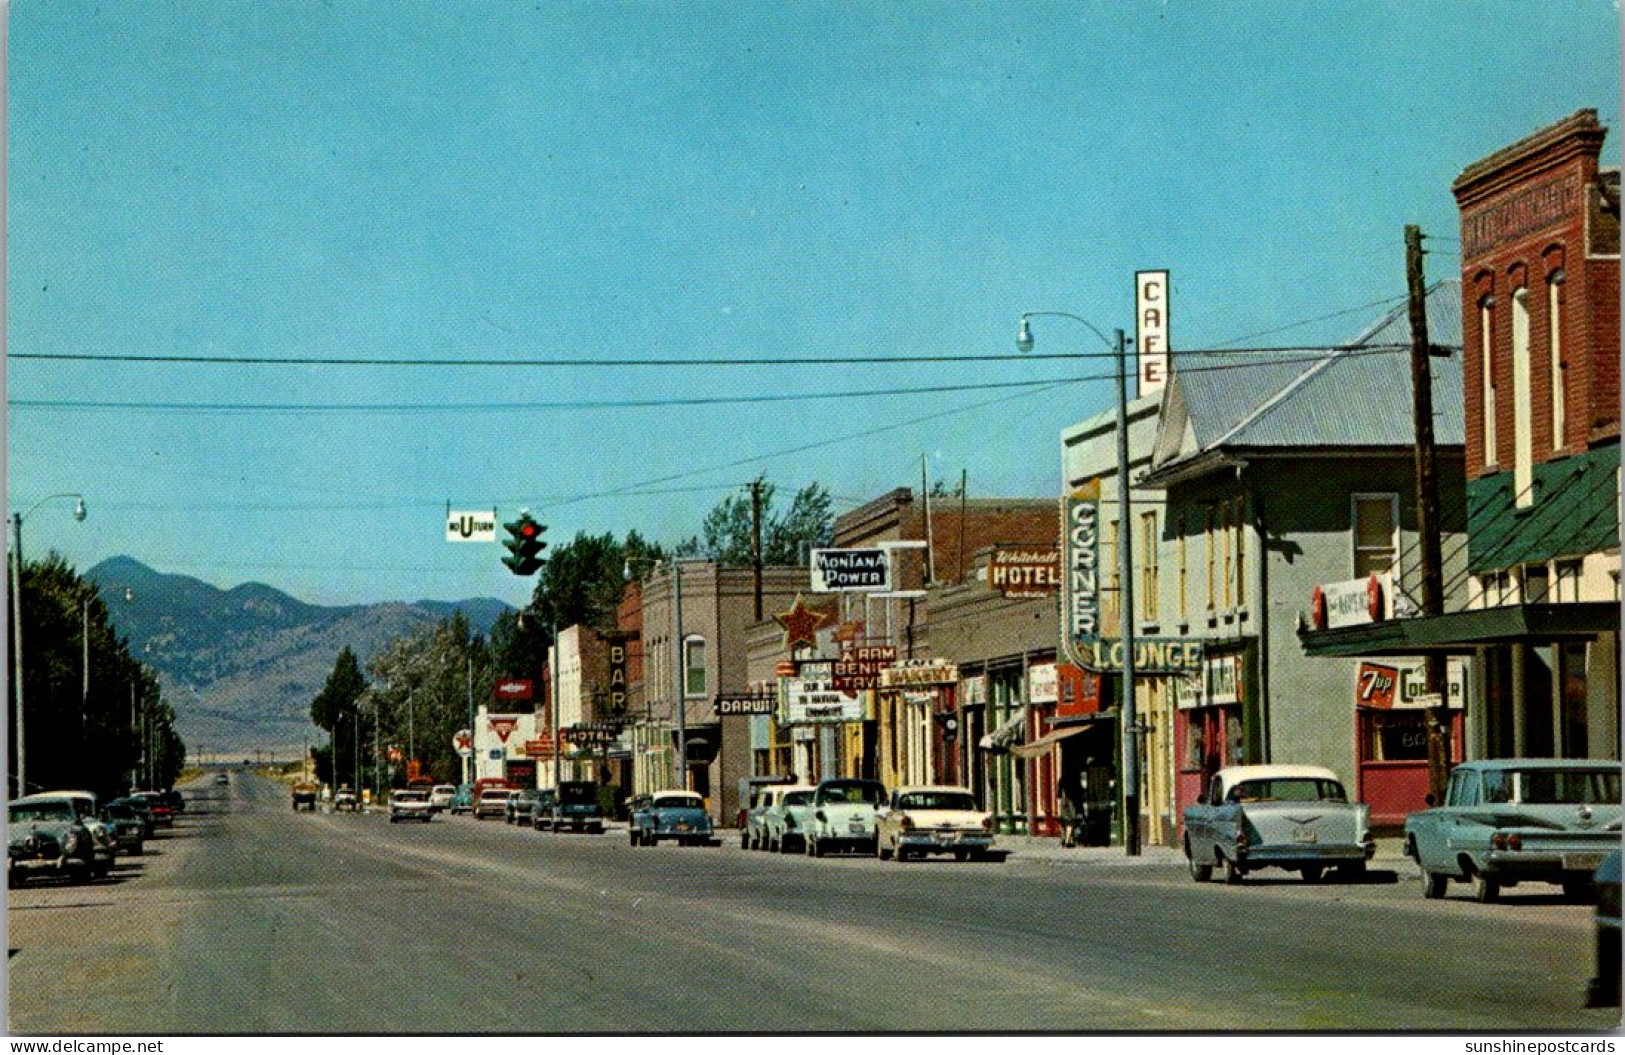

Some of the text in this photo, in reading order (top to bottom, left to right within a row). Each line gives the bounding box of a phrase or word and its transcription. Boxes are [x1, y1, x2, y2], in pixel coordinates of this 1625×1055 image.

[1144, 281, 1161, 383] CAFE
[460, 516, 473, 538] U
[474, 521, 494, 532] TURN
[827, 570, 880, 583] POWER
[993, 566, 1061, 585] HOTEL
[1070, 503, 1097, 635] CORNER
[1093, 641, 1201, 669] LOUNGE
[611, 646, 625, 709] BAR
[1400, 667, 1460, 704] CORR
